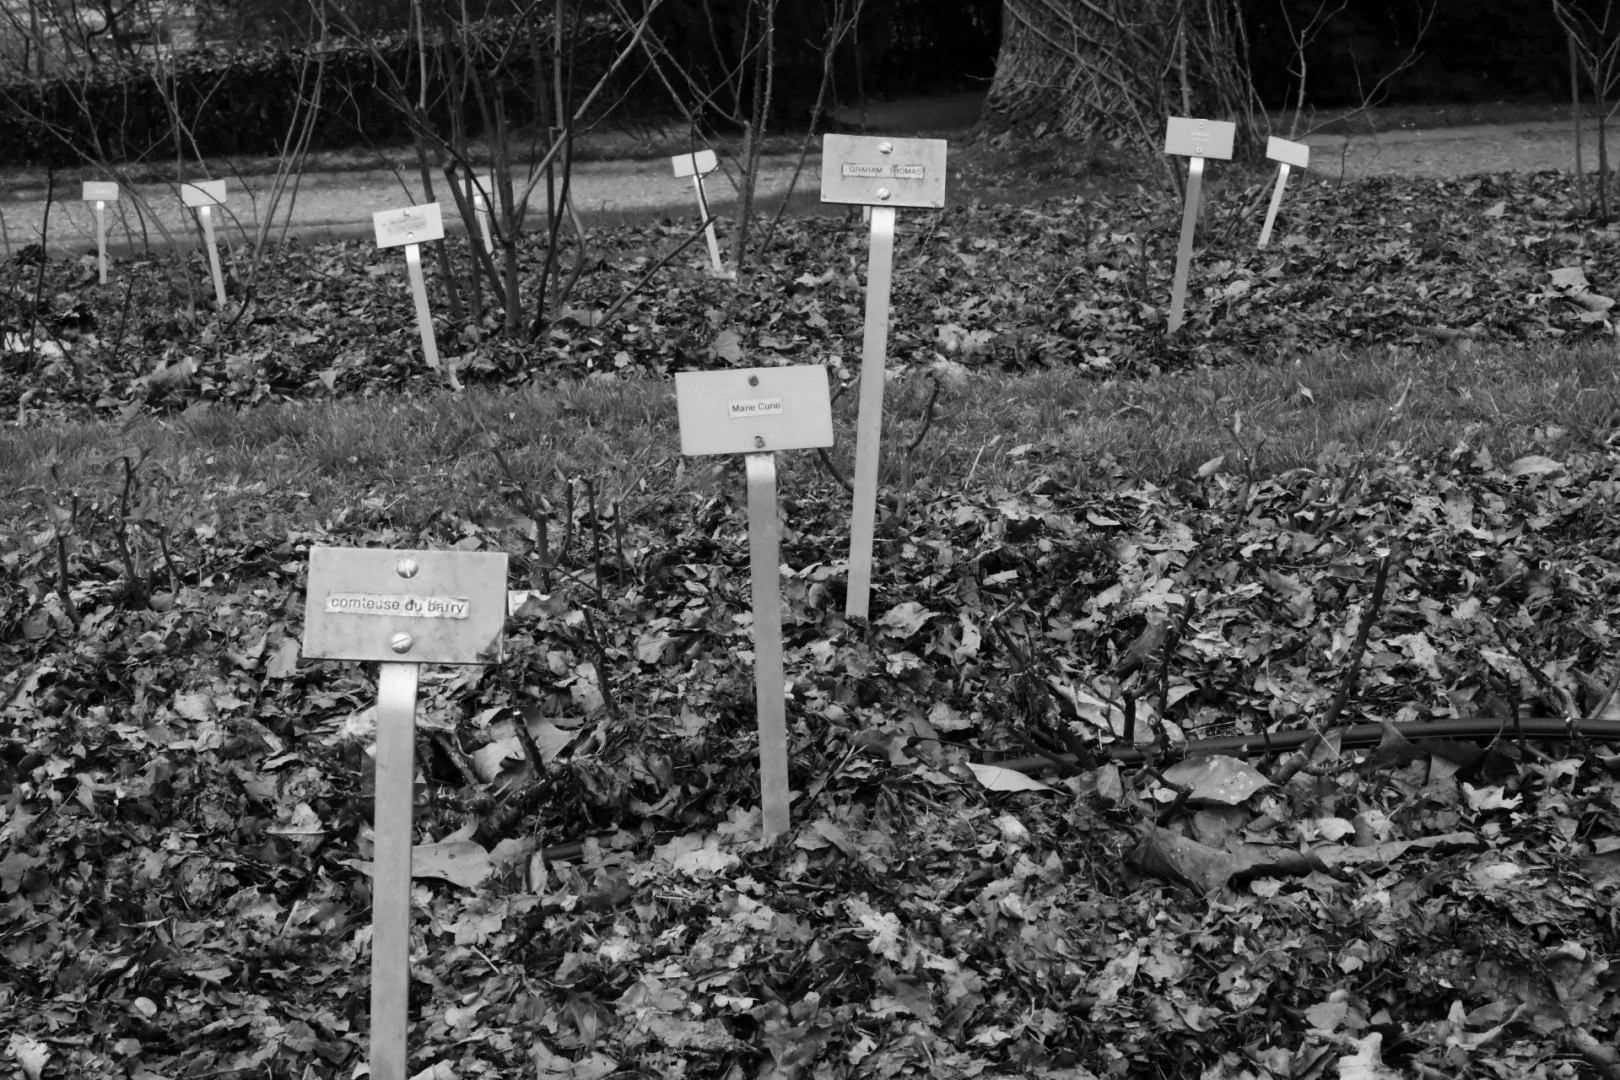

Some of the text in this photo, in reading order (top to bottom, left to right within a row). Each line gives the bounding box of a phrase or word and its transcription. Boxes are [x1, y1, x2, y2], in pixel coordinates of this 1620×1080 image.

[849, 165, 922, 175] GRAHAM THOMAS
[732, 402, 781, 413] Marie Curie
[404, 598, 422, 612] du
[427, 599, 465, 614] barry
